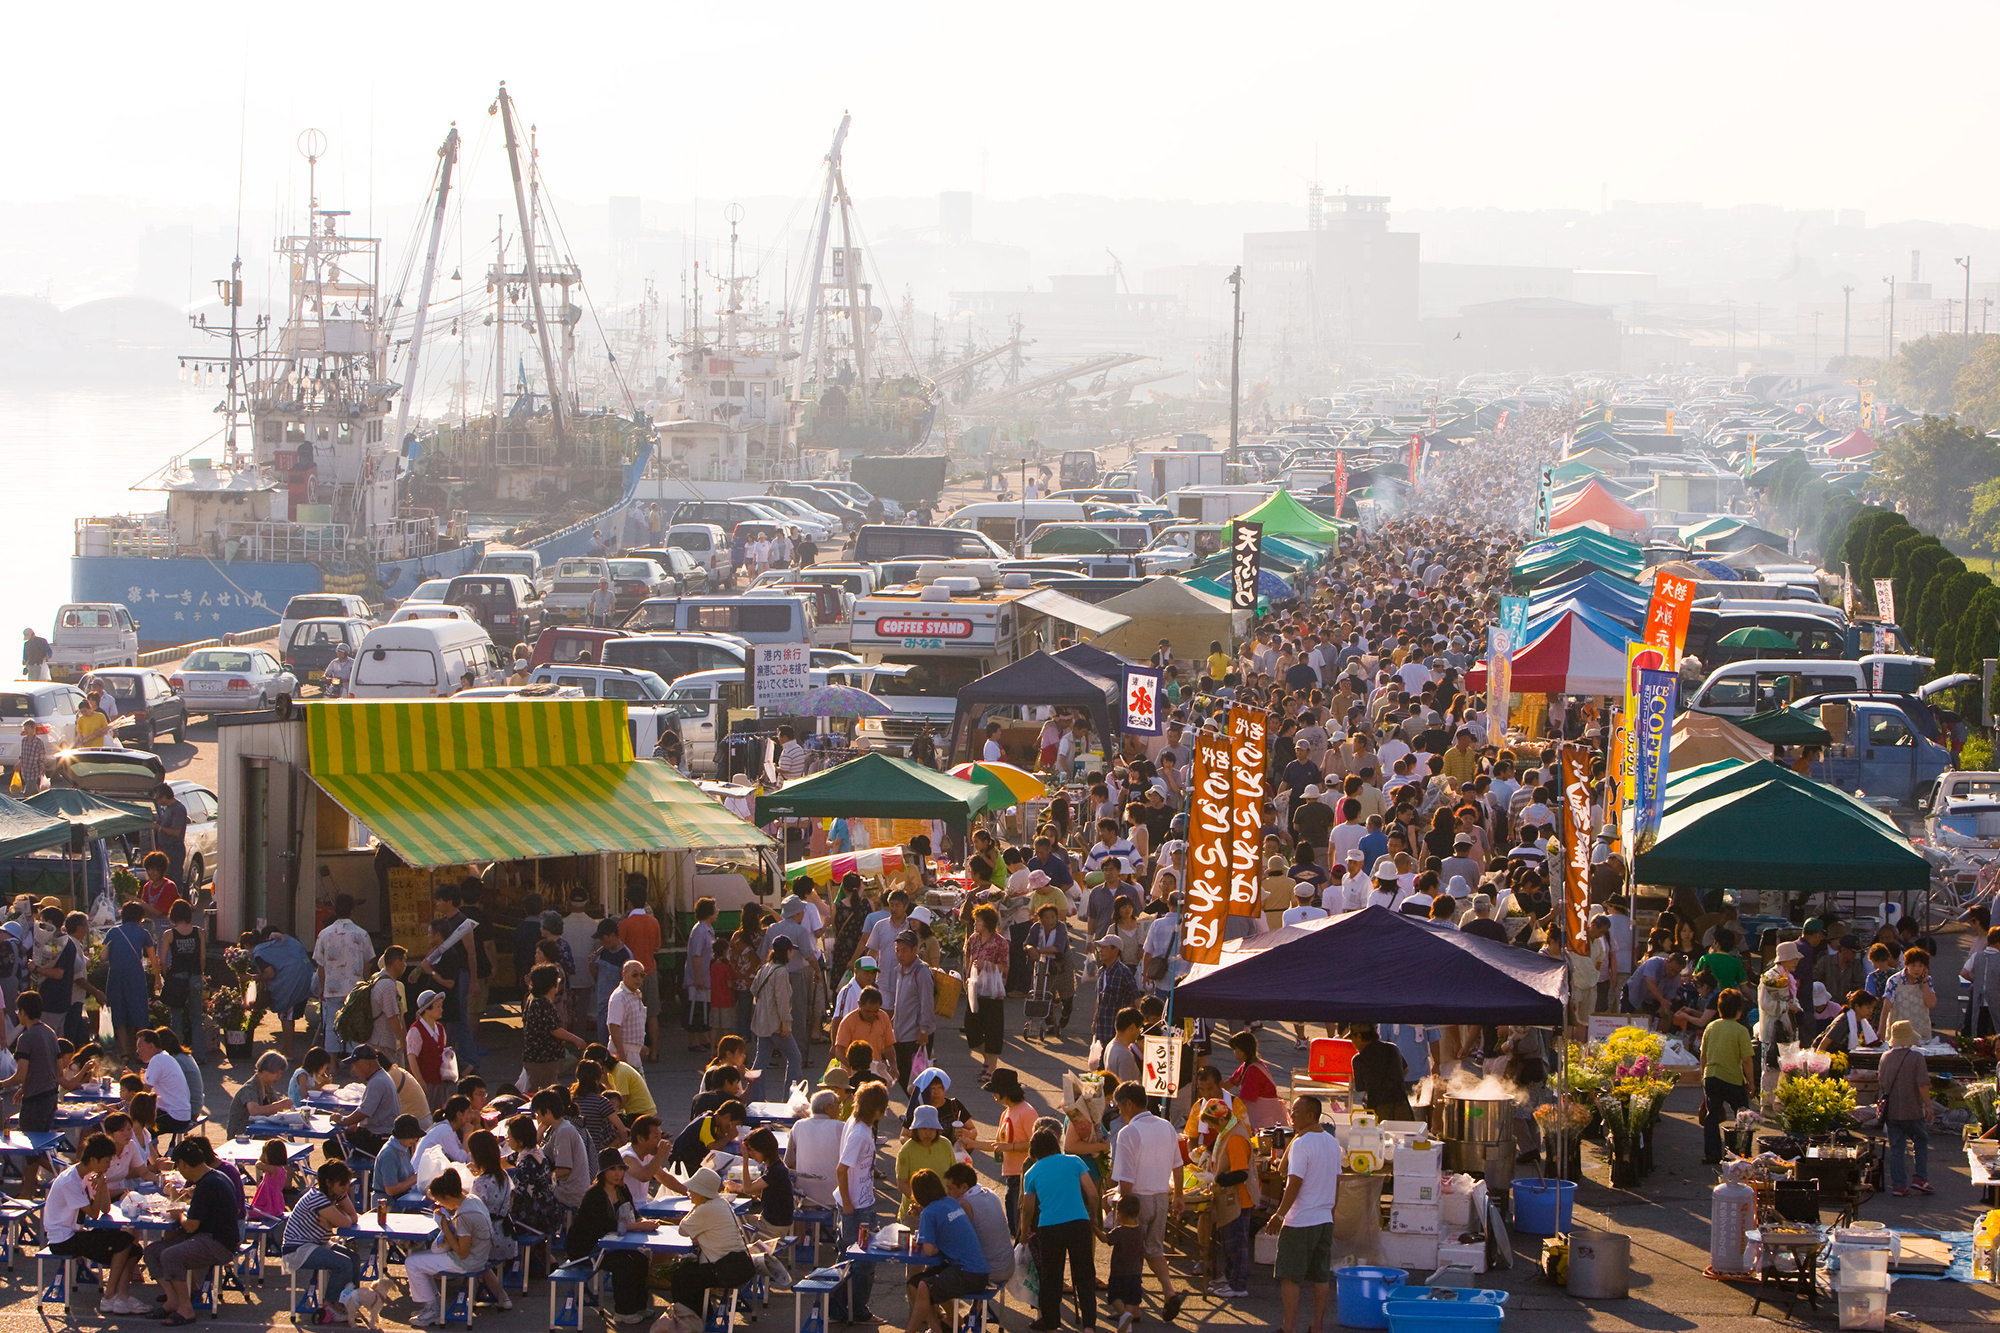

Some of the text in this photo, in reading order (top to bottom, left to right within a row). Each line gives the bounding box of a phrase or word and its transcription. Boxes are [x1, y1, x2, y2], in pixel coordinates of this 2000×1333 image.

[127, 586, 267, 608] 第十一きんせい丸
[883, 620, 966, 635] COFFEE STAND
[764, 648, 801, 662] 港内徐行
[757, 663, 808, 677] 漁港にごみを捨て
[757, 678, 804, 690] ないでください。
[1652, 684, 1670, 697] ICE
[1154, 1045, 1167, 1091] うどん
